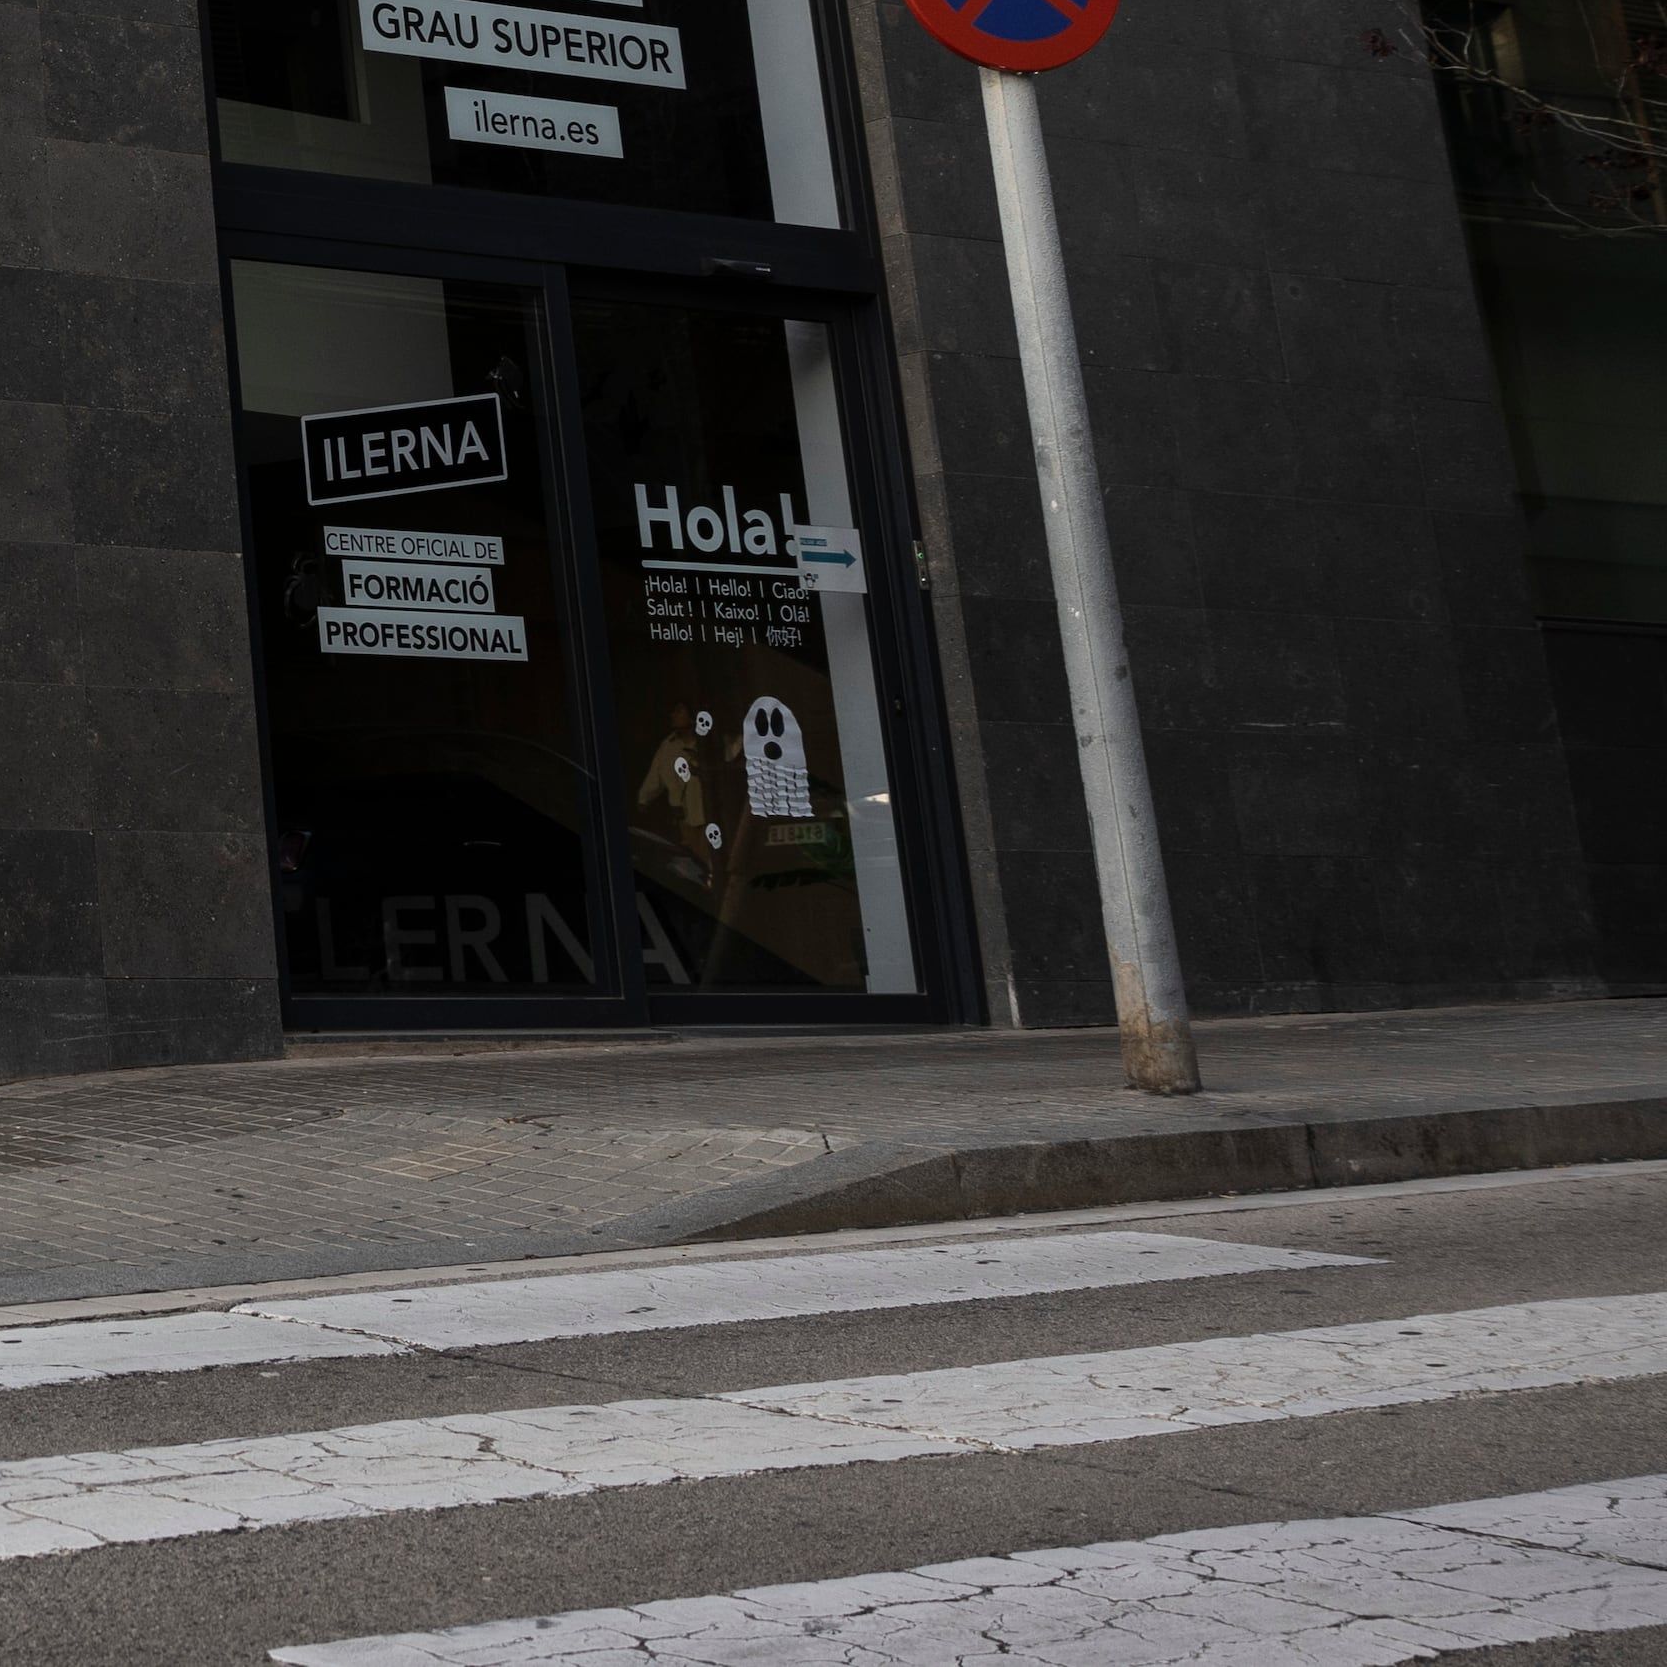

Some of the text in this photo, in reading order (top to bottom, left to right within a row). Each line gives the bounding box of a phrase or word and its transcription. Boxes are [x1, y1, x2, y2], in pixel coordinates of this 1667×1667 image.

[373, 2, 673, 74] GRAU SUPERIOR
[473, 100, 600, 146] ilerna.es
[323, 421, 490, 481] ILERNA
[634, 483, 798, 557] Hola!
[326, 533, 498, 559] CENTRE OFICIAL DE
[349, 573, 489, 605] FORMACIÓ
[645, 575, 688, 597] ¡Hola!
[709, 578, 751, 597] Hello!
[772, 582, 810, 600] Ciao!
[714, 602, 759, 620] Kaixo!
[780, 605, 810, 623] Olá!
[326, 621, 522, 654] PROFESSIONAL
[650, 623, 692, 642] Hallo!
[714, 626, 744, 648] Hej!
